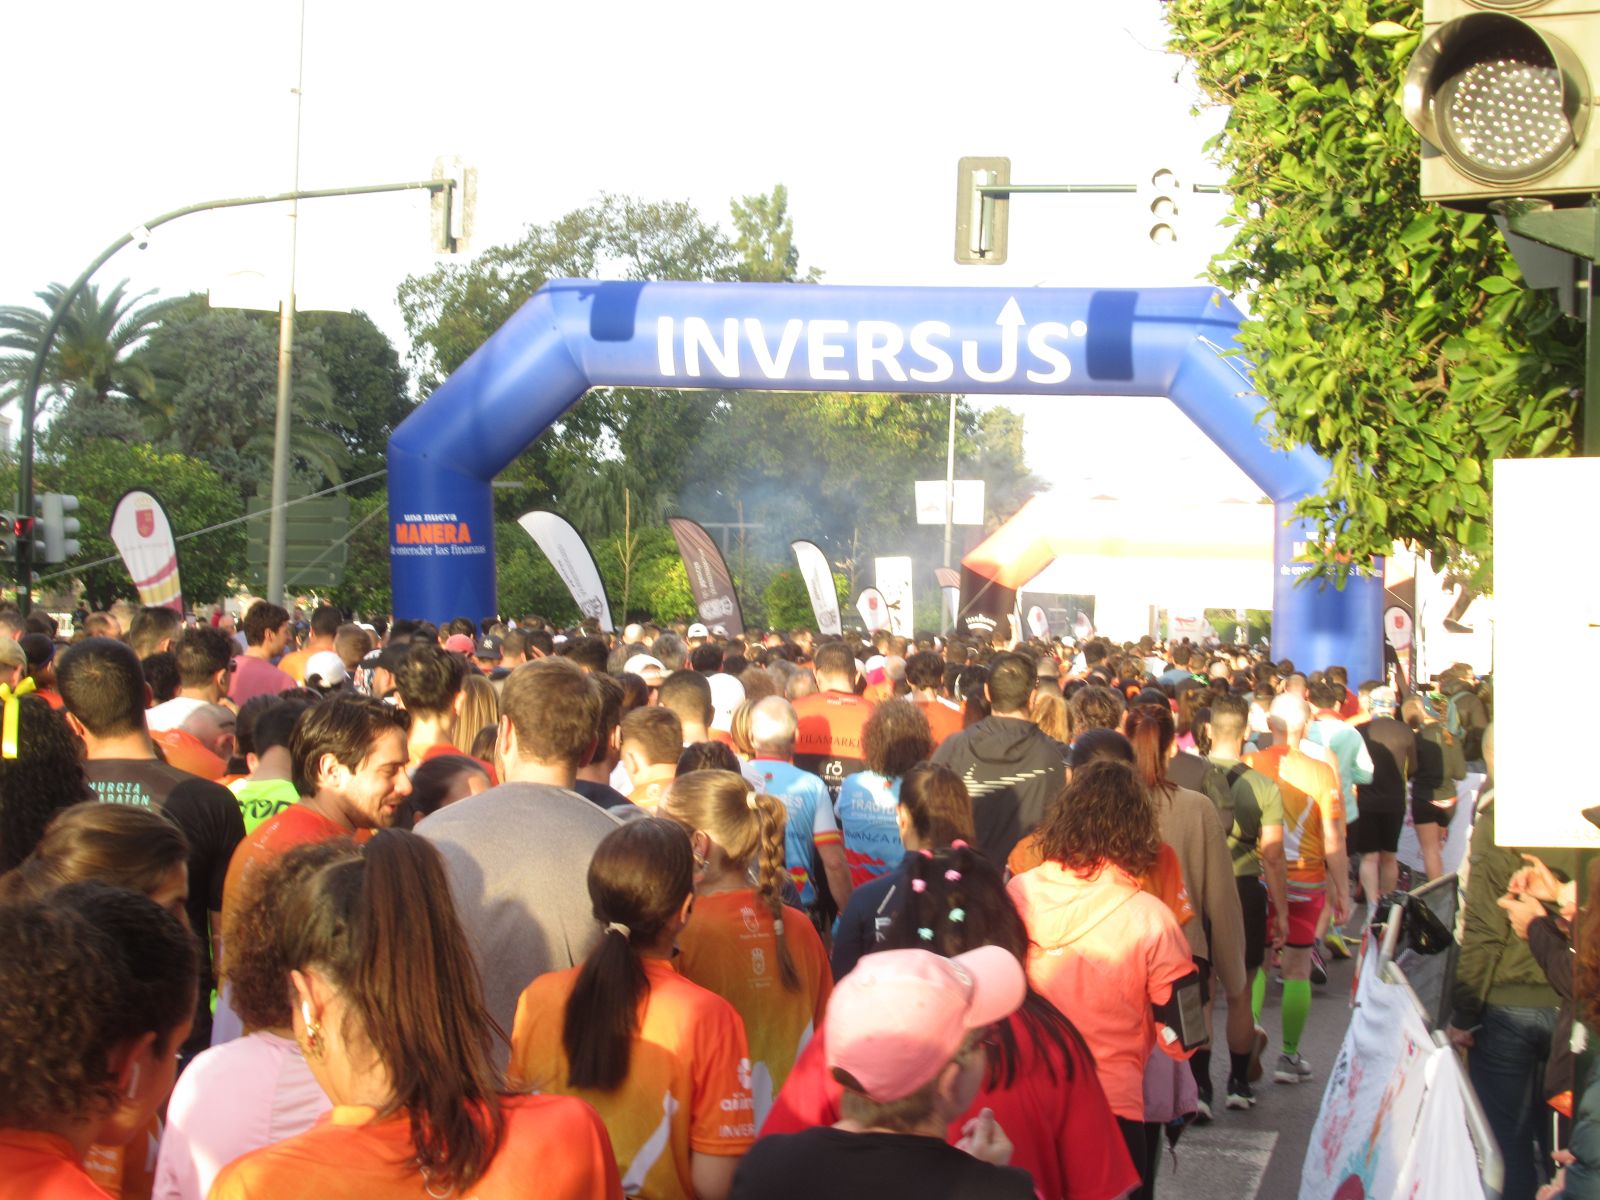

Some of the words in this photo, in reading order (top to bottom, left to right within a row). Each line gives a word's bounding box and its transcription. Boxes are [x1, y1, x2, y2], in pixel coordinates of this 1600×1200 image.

[657, 296, 1072, 384] INVERSUS
[404, 513, 422, 521] una
[424, 513, 457, 521] nueva
[396, 522, 472, 544] MANERA
[88, 781, 140, 793] MURCIA
